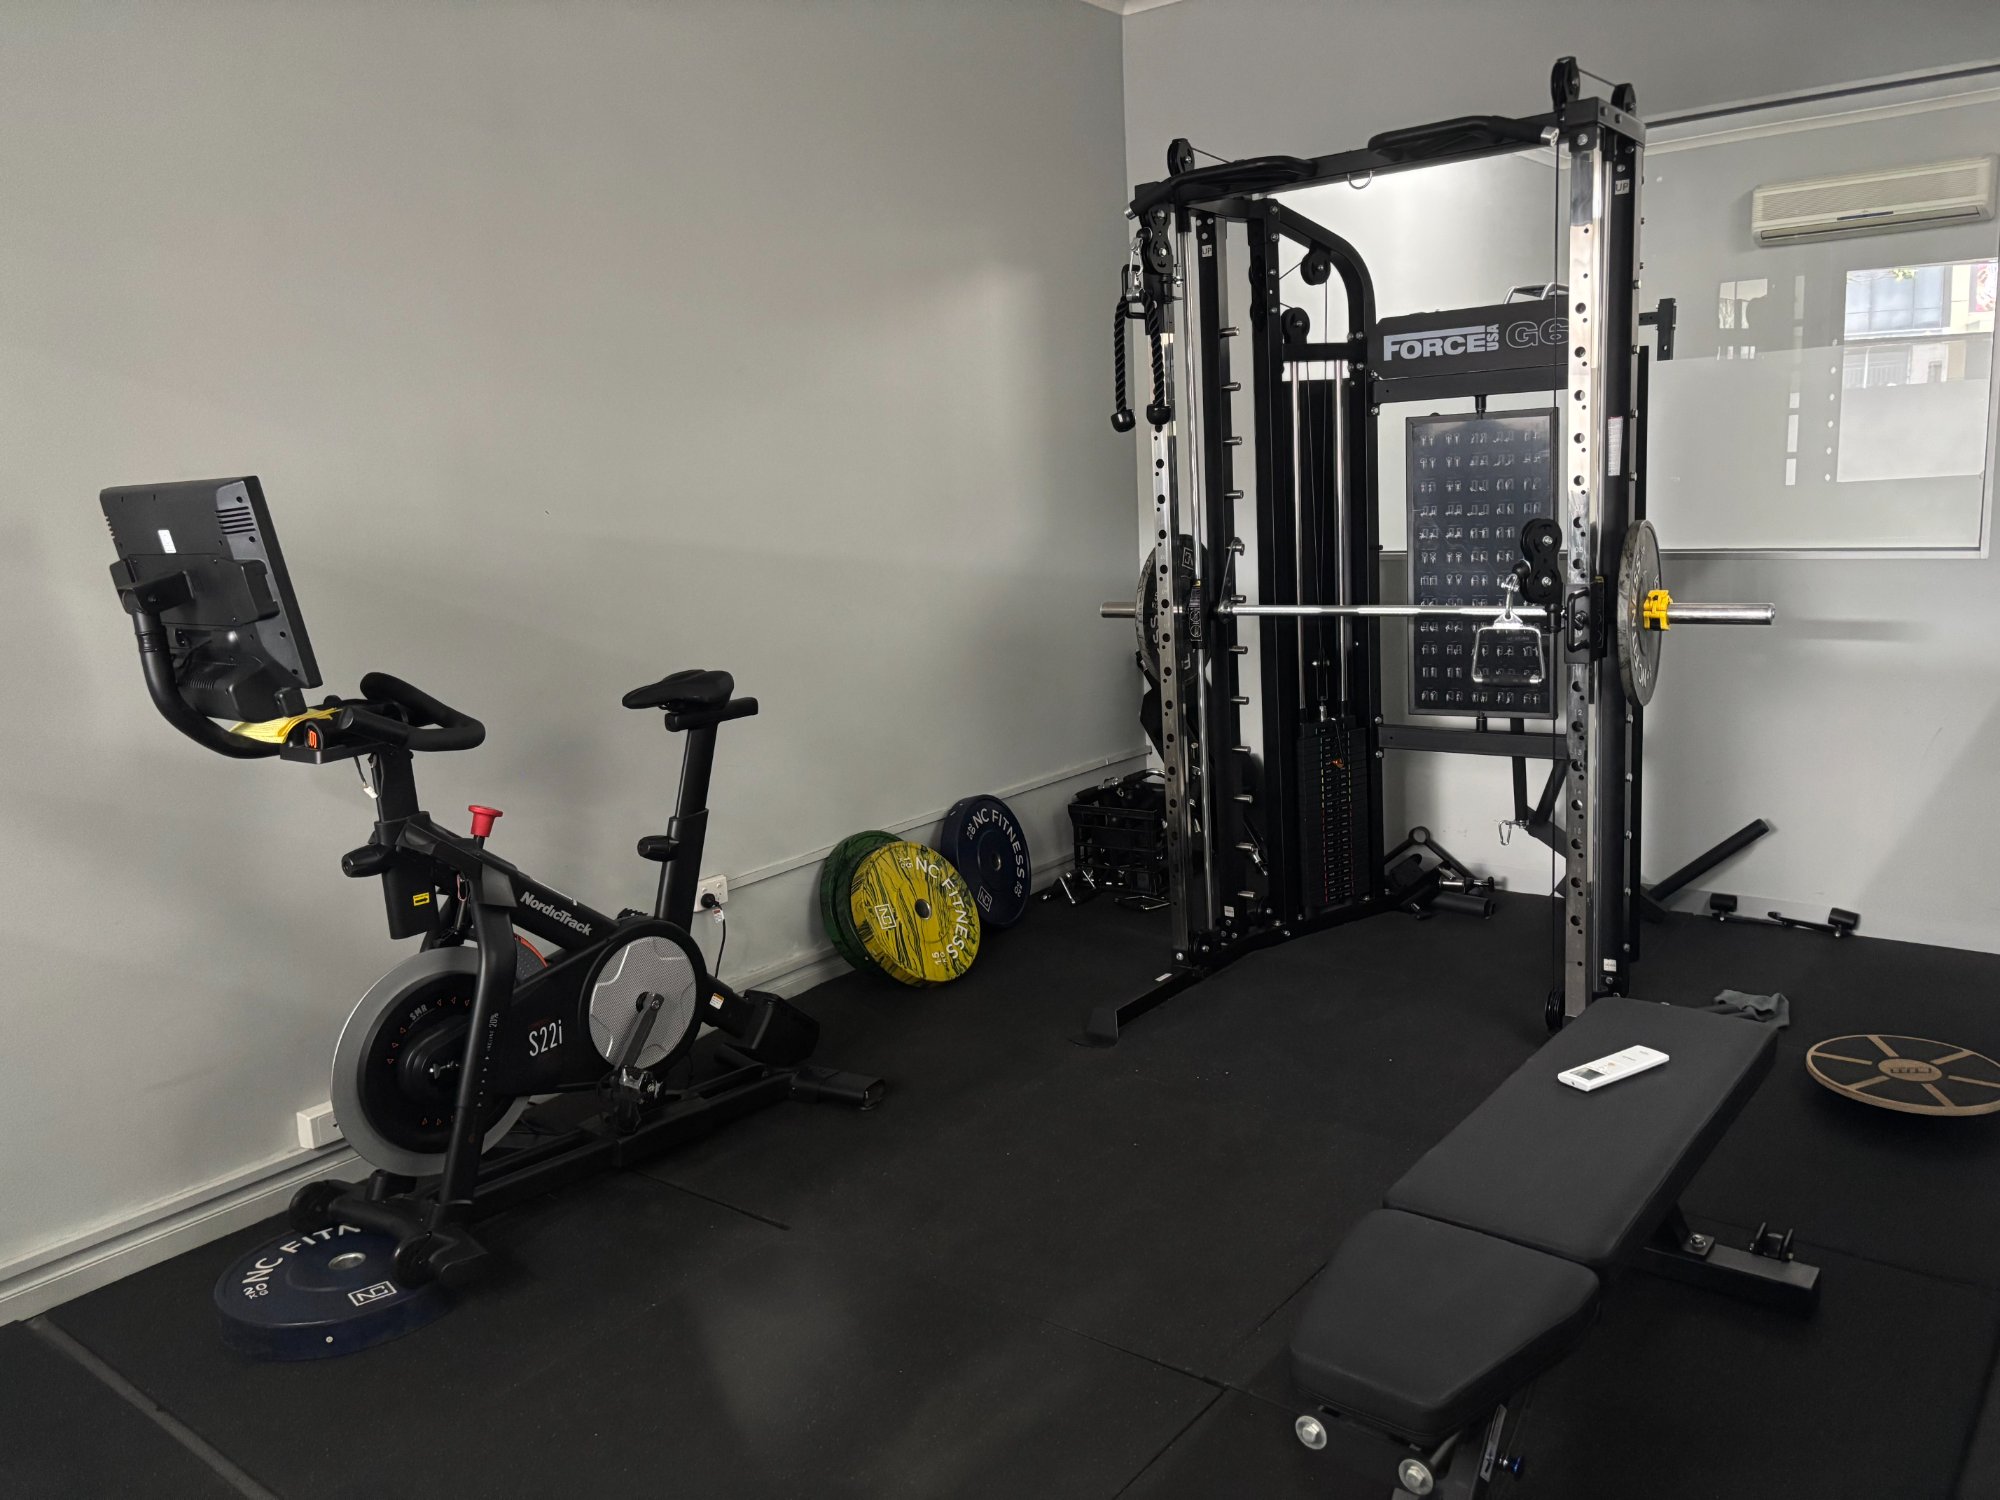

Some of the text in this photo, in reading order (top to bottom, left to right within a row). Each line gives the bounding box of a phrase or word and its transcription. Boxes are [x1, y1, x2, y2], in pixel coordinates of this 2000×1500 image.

[1615, 182, 1629, 192] UP
[1202, 246, 1212, 255] UP
[1383, 325, 1486, 362] FORCE
[1486, 323, 1500, 352] USA
[1506, 317, 1569, 349] G6
[972, 807, 1026, 879] NC FITNESS
[519, 890, 593, 937] NordicTrack
[915, 856, 970, 960] NC FITNESS
[409, 1003, 428, 1021] SMR
[488, 1012, 499, 1028] 20%
[528, 1019, 563, 1058] S22i
[241, 1257, 284, 1284] NC
[243, 1282, 268, 1297] 20
